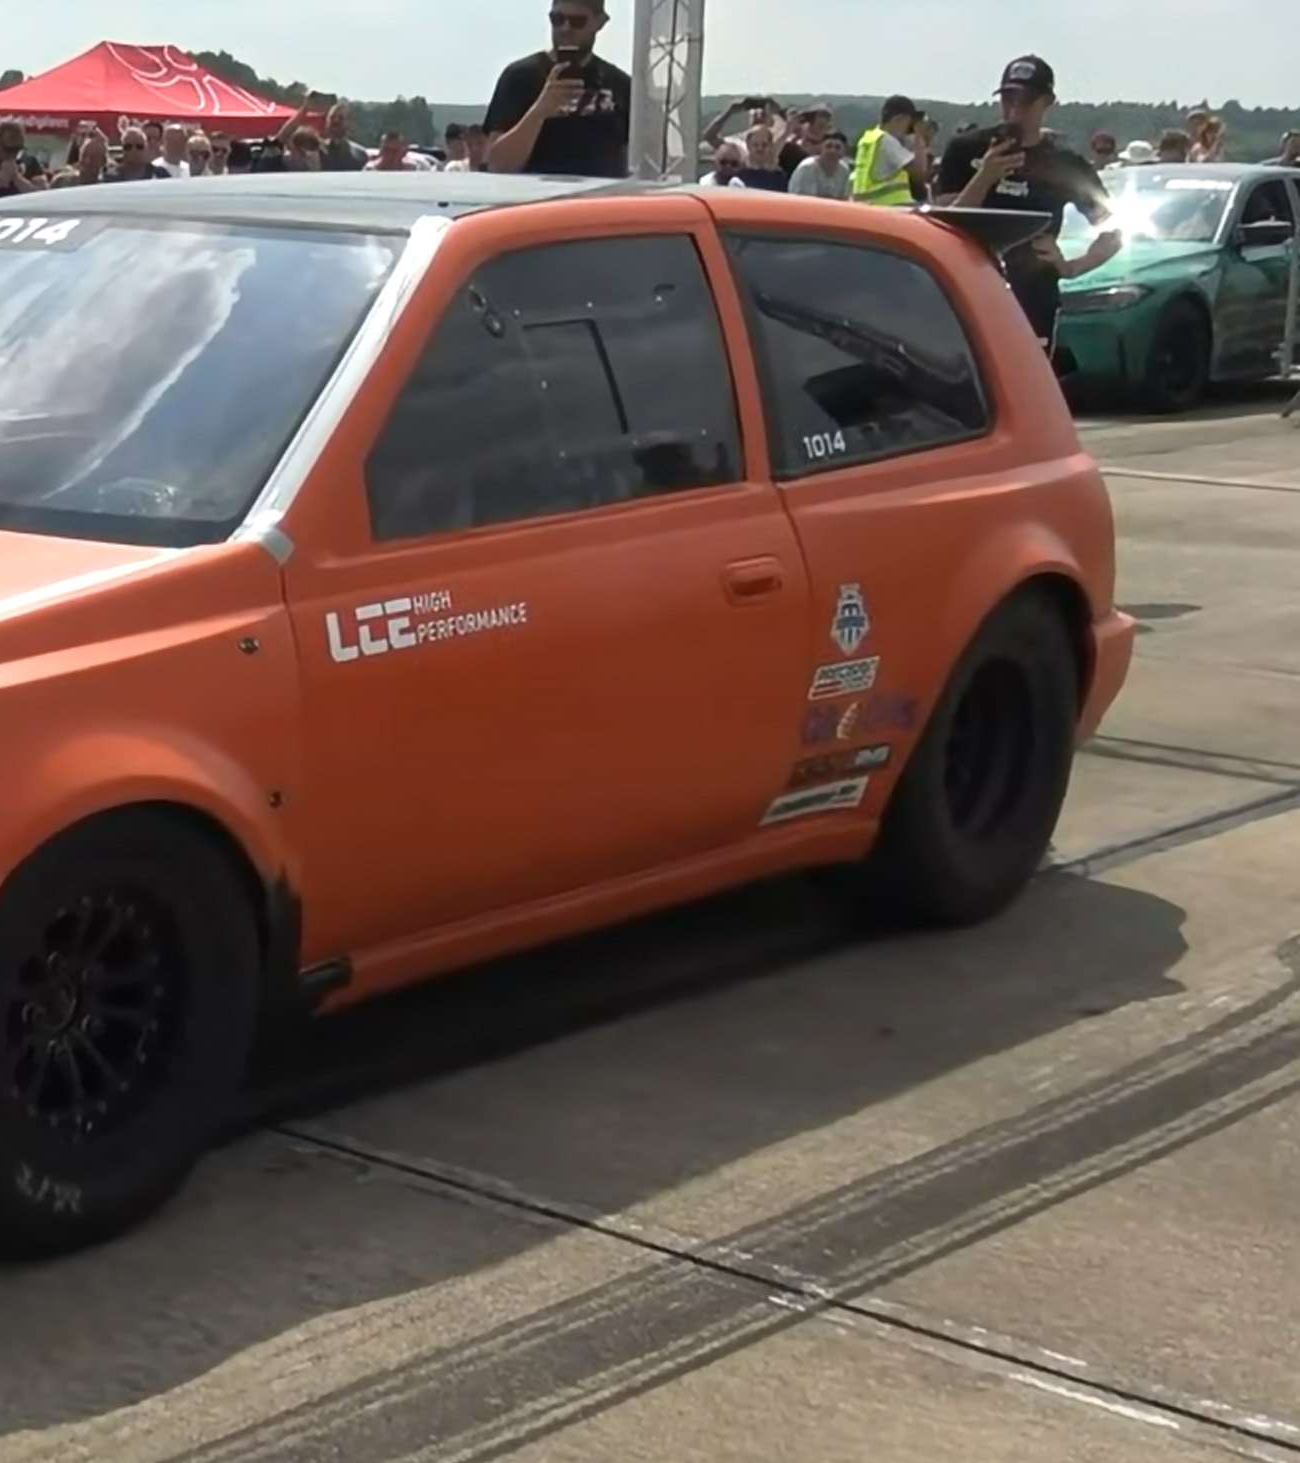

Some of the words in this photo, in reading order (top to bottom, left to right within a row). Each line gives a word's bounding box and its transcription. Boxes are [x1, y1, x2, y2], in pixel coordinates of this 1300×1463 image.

[803, 430, 846, 459] 1014
[412, 589, 452, 616] HIGH
[325, 597, 417, 663] LCE
[415, 602, 528, 644] PERFORMANCE
